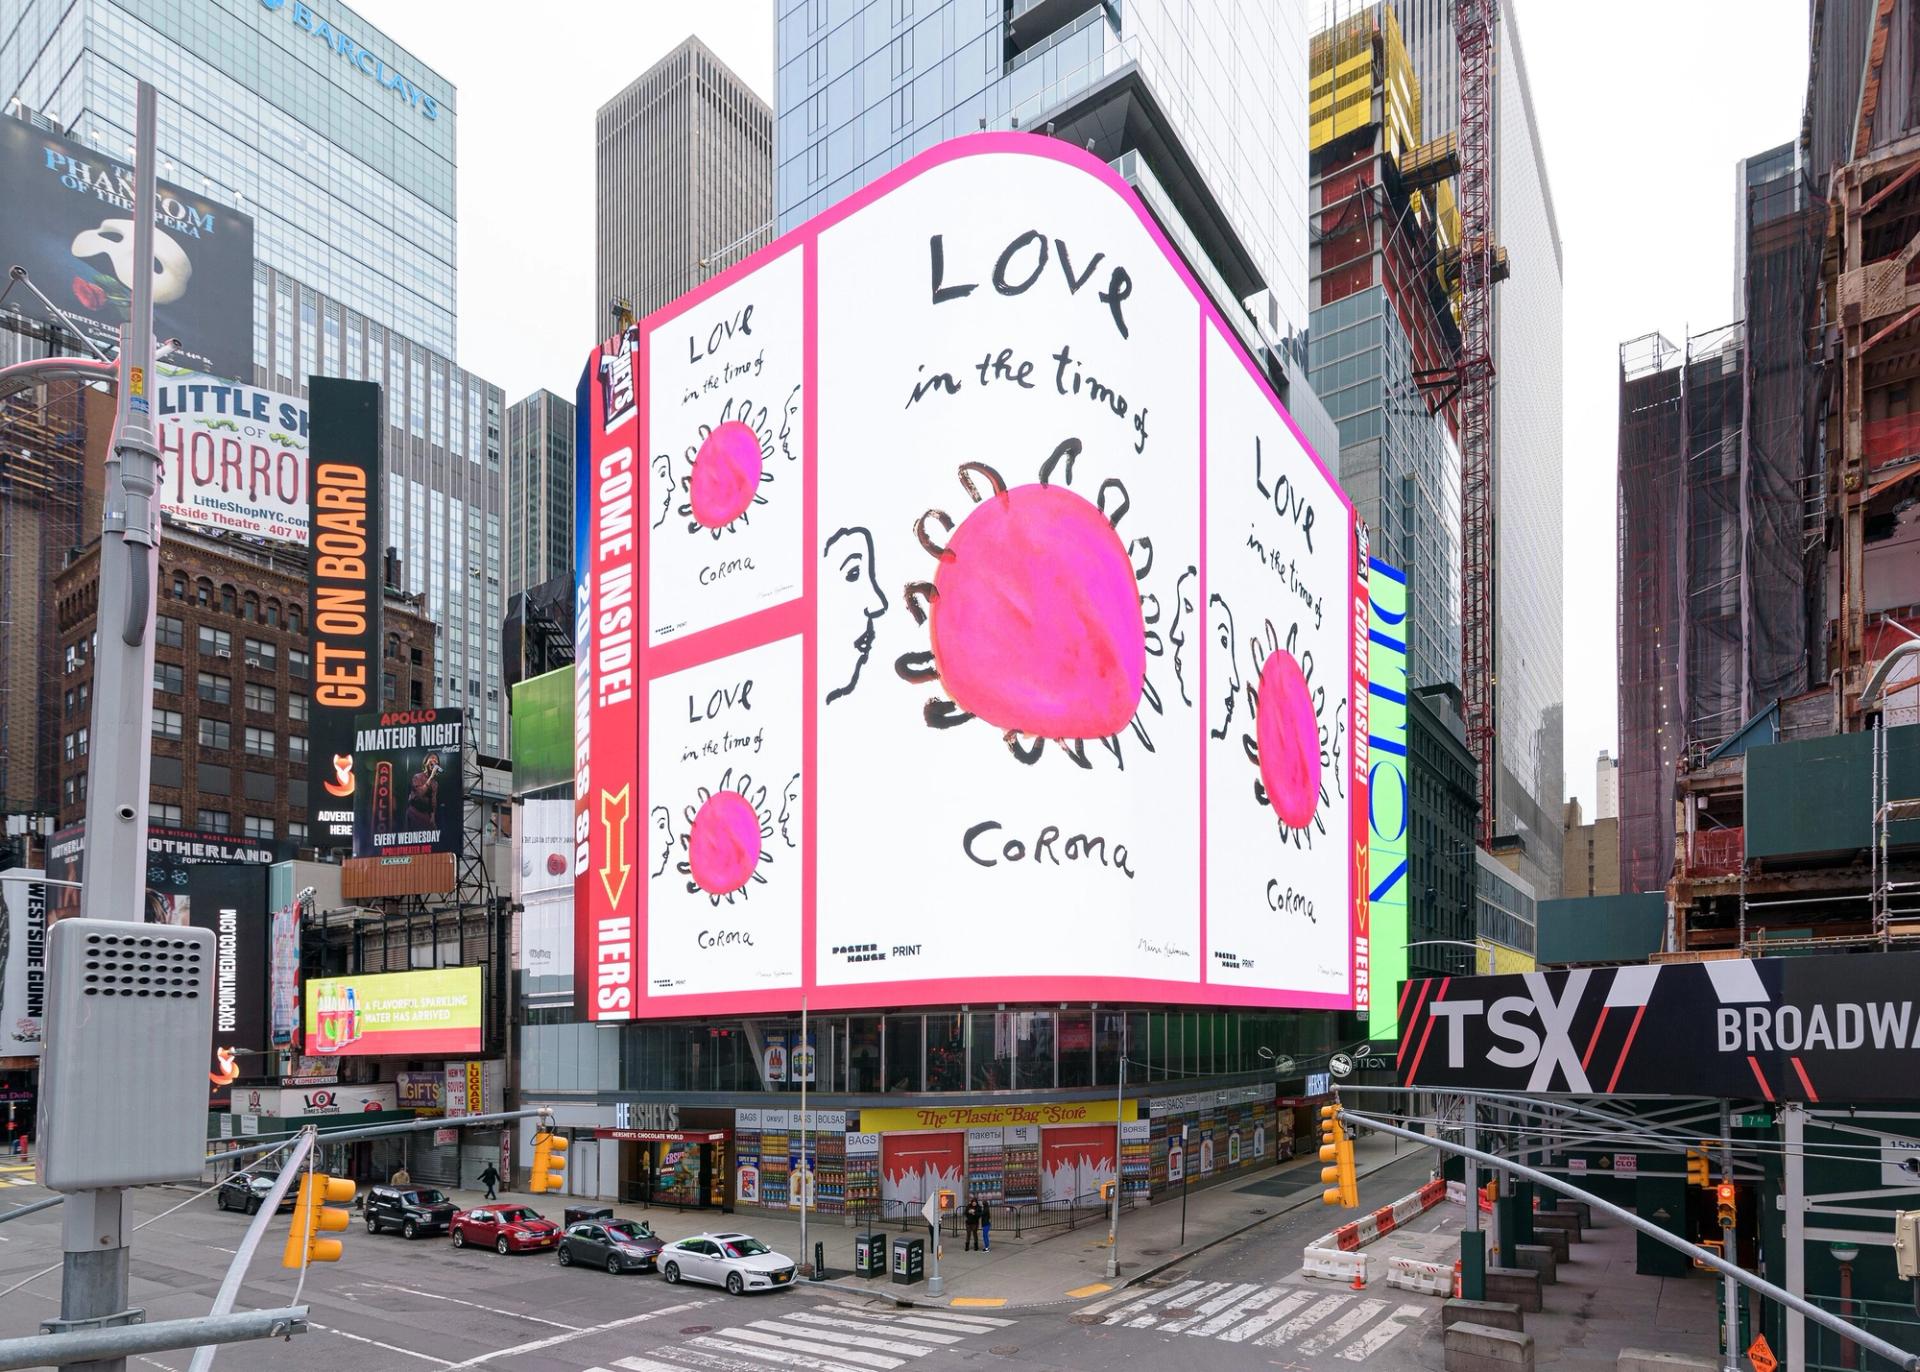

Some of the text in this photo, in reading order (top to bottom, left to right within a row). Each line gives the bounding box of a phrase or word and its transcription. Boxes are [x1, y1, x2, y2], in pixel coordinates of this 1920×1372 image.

[293, 1, 439, 120] BARCLAYS
[61, 175, 89, 193] OF
[155, 212, 200, 239] PERA
[682, 349, 764, 406] in the time of
[159, 385, 270, 423] LITTLE
[905, 345, 1148, 454] in the time of
[244, 425, 266, 438] OF
[159, 422, 309, 505] HORRO
[212, 512, 260, 531] Theatre
[269, 524, 292, 536] 407
[316, 462, 367, 708] GET ON BOARD
[599, 447, 633, 708] COME INSIDE!
[1247, 523, 1323, 631] in the time of
[1355, 597, 1369, 786] COME INSIDE!
[381, 710, 436, 726] APOLLO
[576, 646, 591, 800] TIMES
[356, 722, 461, 752] AMATEUR NIGHT
[681, 728, 763, 762] in the time of
[329, 825, 353, 835] HERE
[374, 830, 441, 846] EVERY WEDNESDAY
[148, 838, 272, 863] OTHERLAND
[27, 883, 45, 967] WESTSIDE
[892, 944, 922, 957] PRINT
[219, 909, 236, 1032] FOXPOINTMEDIACO.COM
[27, 969, 45, 1018] GUNN
[373, 999, 418, 1010] FLAVORFUL
[421, 995, 468, 1007] SPARKLING
[365, 1009, 449, 1023] WATER HAS ARRIVED
[1430, 969, 1593, 1093] TSX
[1717, 1001, 1920, 1053] BROADW
[304, 1091, 338, 1109] LOL
[406, 1083, 440, 1100] GIFTS
[470, 1063, 480, 1111] LUGGAGE
[616, 1102, 681, 1132] HERSHEY'S
[740, 1113, 757, 1121] BAGS
[818, 1114, 844, 1124] BOLSAS
[917, 1105, 1087, 1129] The Plastic Bag Store
[1749, 1116, 1754, 1125] 7
[638, 1132, 665, 1140] CHOCOLATE
[848, 1135, 876, 1145] BAGS
[970, 1131, 1001, 1141] пакеты
[1016, 1128, 1027, 1141] 백
